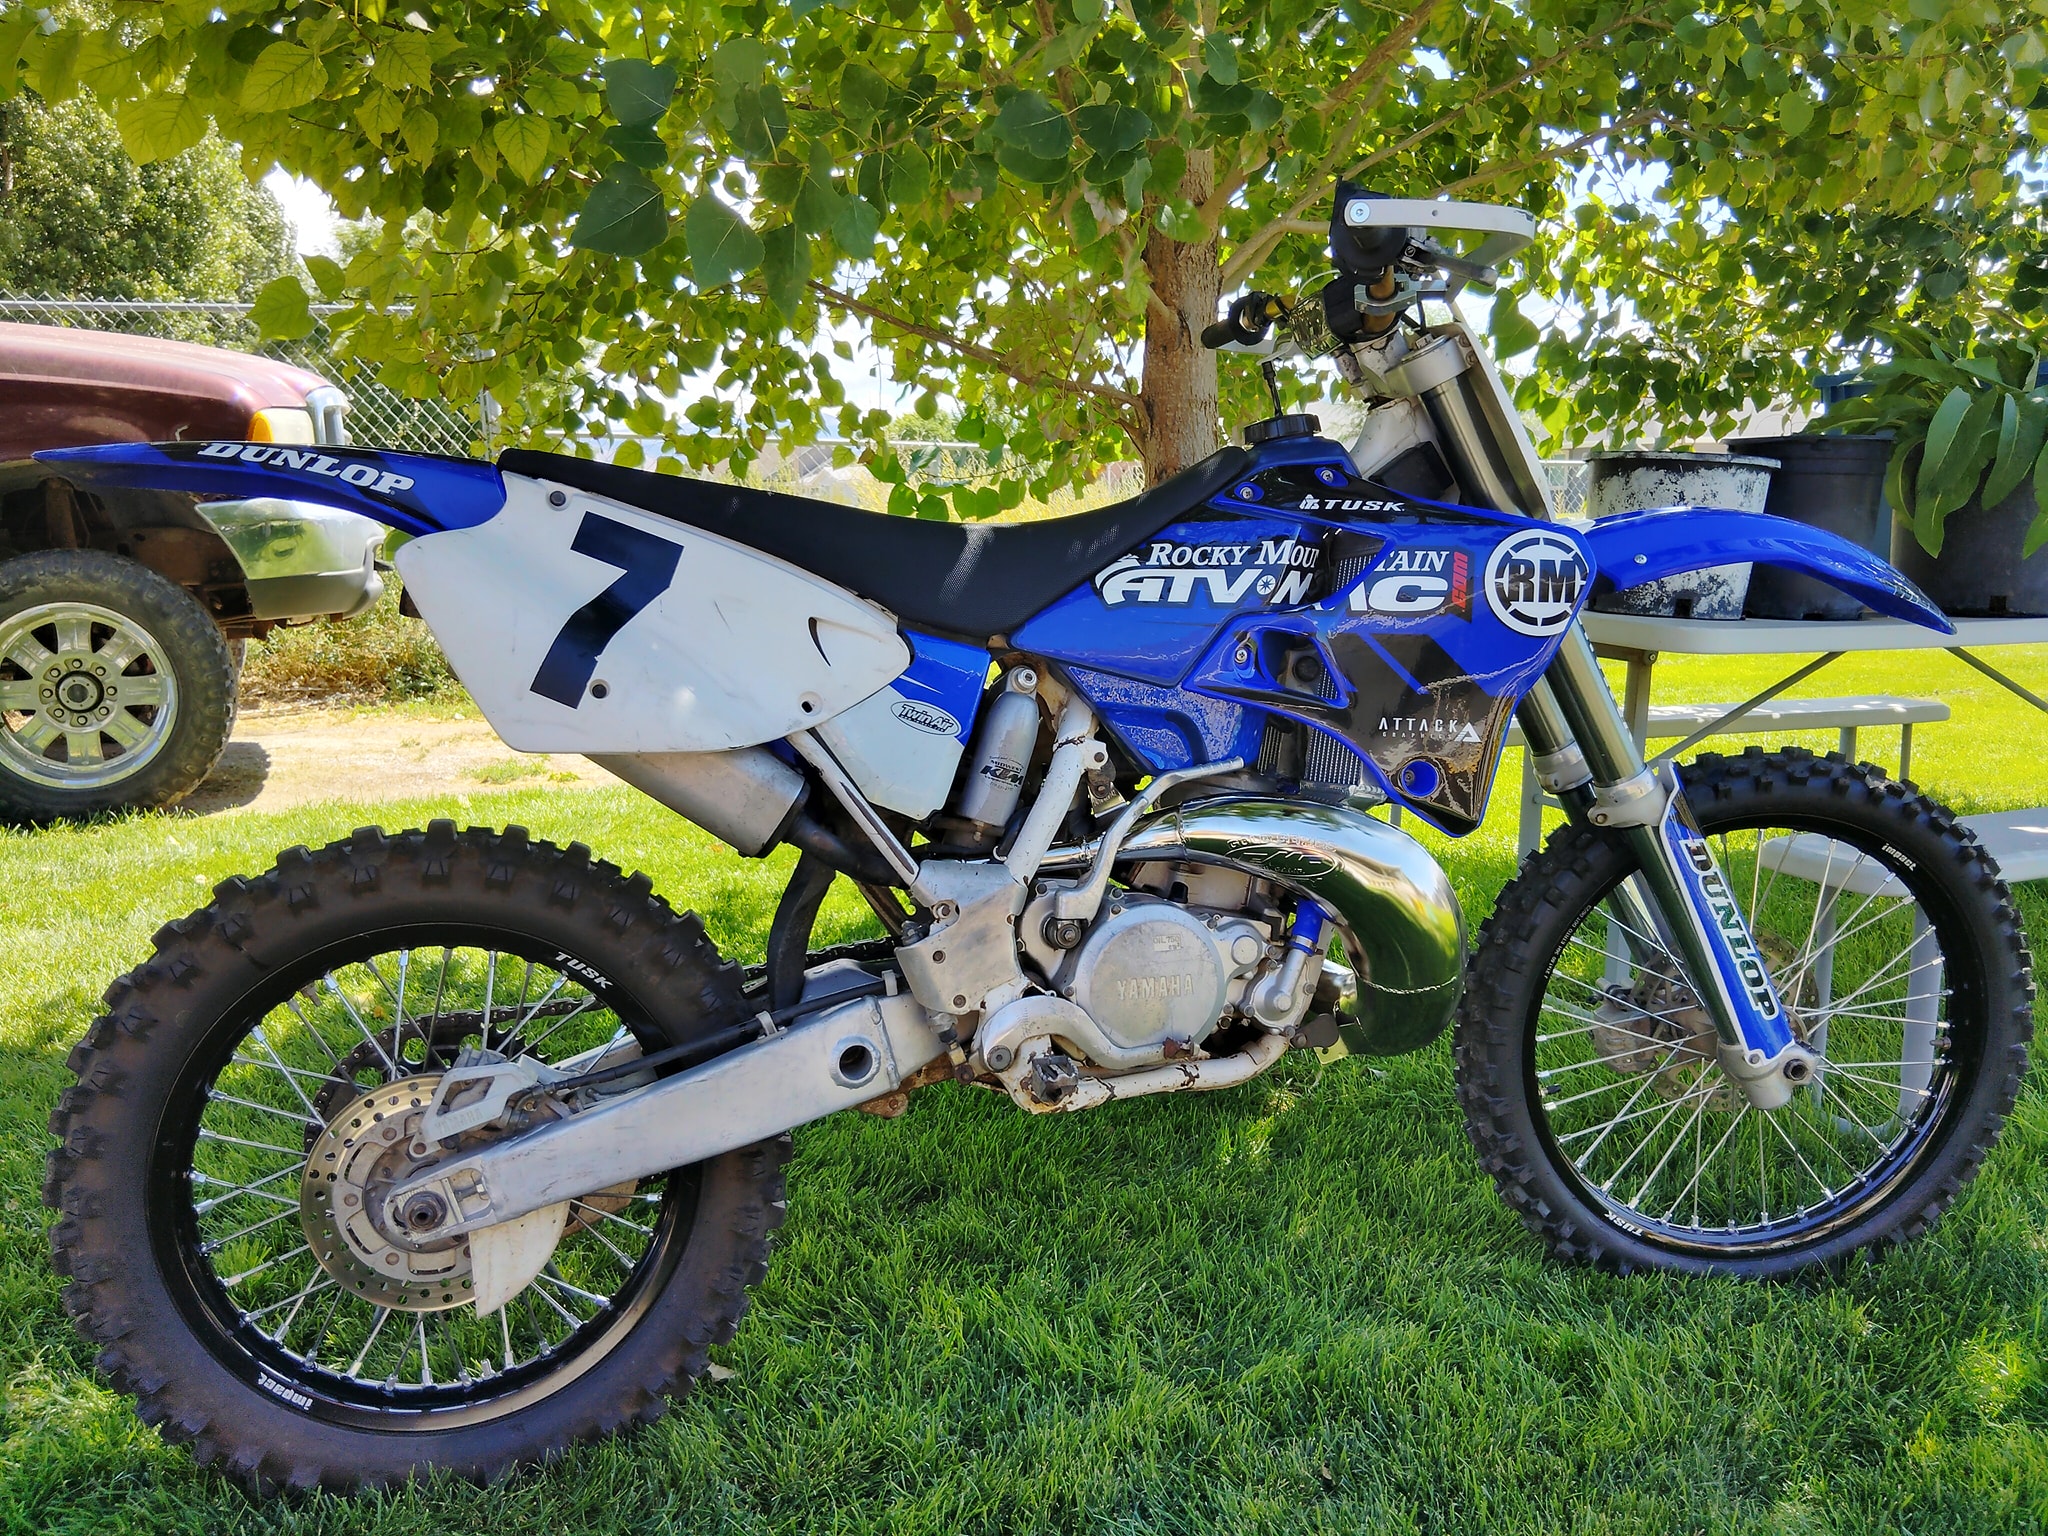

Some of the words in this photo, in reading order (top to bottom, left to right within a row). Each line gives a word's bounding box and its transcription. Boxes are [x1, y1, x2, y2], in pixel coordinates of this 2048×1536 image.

[198, 443, 415, 494] DUNLOP
[1324, 499, 1405, 511] TUSK
[1146, 543, 1251, 566] ROCKY
[1508, 559, 1576, 603] RM
[530, 511, 685, 710] 7
[1379, 717, 1458, 732] ATTACK
[980, 765, 1024, 785] KTM
[1881, 843, 1916, 871] impact
[1679, 839, 1779, 1020] DUNLOP
[555, 951, 614, 989] TUSK
[1117, 974, 1194, 1001] YAMAHA
[1604, 1210, 1643, 1237] TUSK
[257, 1371, 314, 1411] impact
